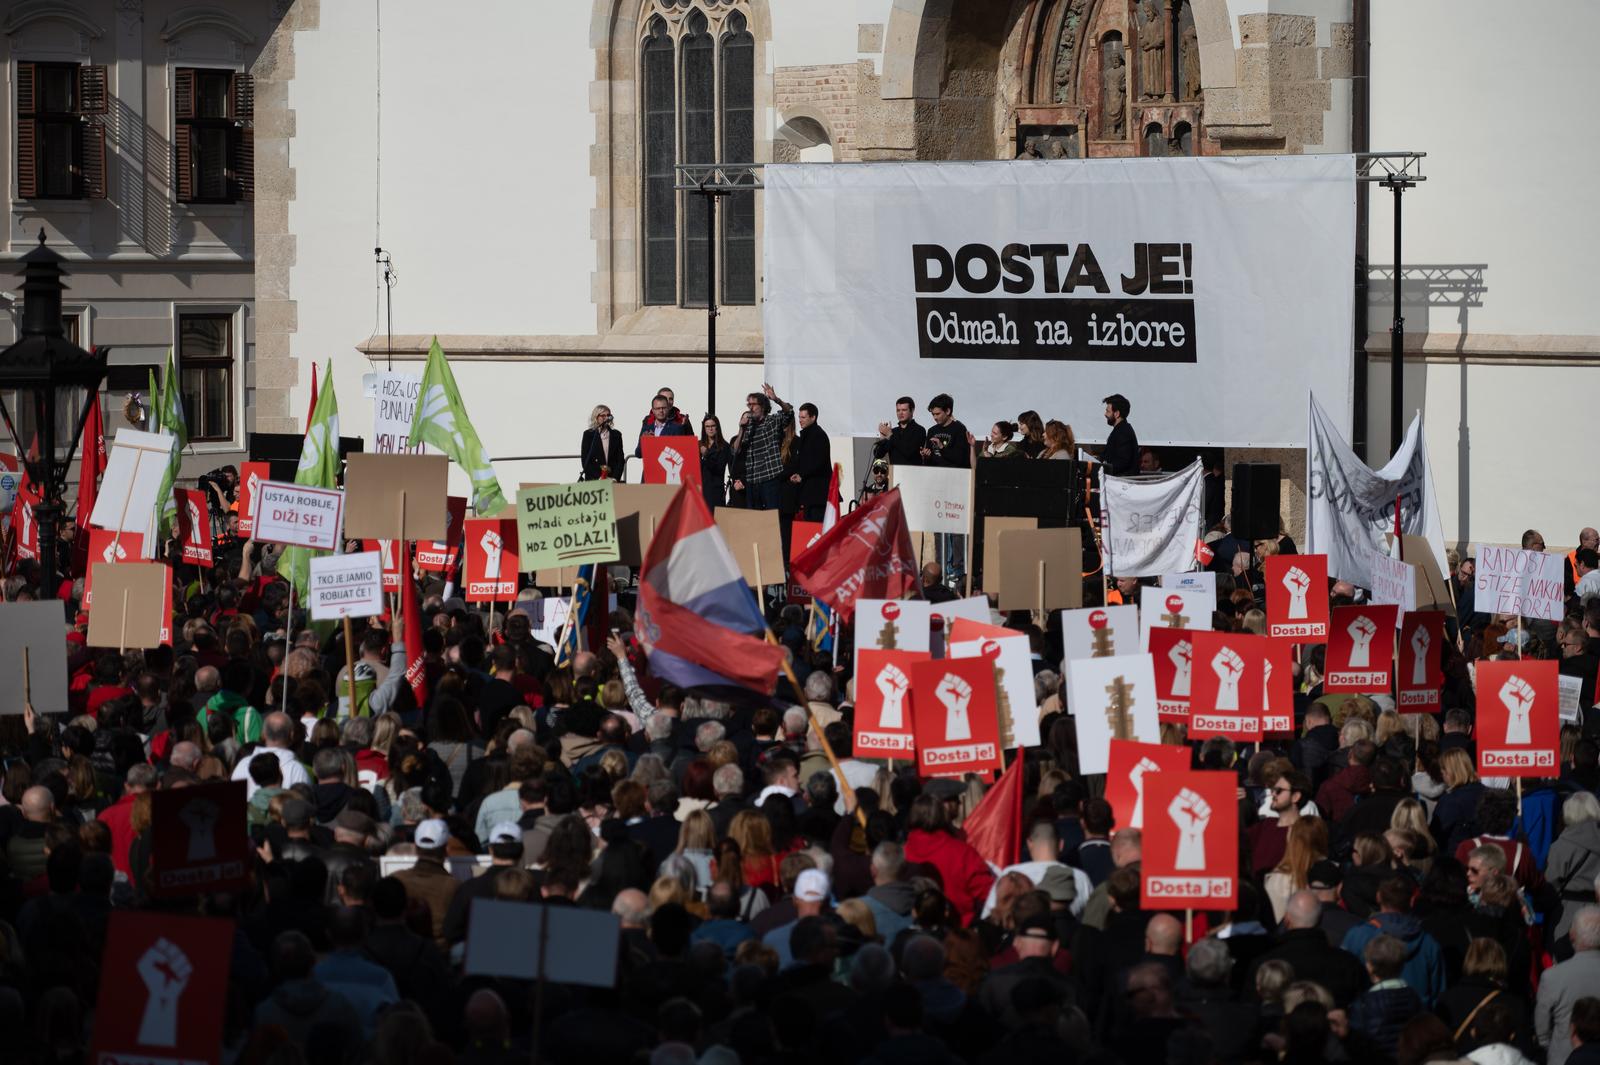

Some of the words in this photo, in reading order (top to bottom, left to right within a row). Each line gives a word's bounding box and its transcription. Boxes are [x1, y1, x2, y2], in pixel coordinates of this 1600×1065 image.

[912, 243, 1111, 294] DOSTA
[1120, 243, 1193, 295] JE!
[926, 310, 1019, 345] Odmah
[1034, 320, 1072, 345] na
[1087, 313, 1186, 347] izbore
[265, 491, 294, 504] USTAJ
[297, 496, 334, 511] ROBLJE,
[526, 486, 609, 512] BUDUĆNOST:
[272, 508, 298, 523] DIŽI
[302, 514, 323, 527] SE!
[527, 515, 562, 531] mladi
[567, 510, 606, 528] ostaju
[526, 541, 548, 552] HDZ
[553, 522, 616, 549] ODLAZI!
[419, 553, 442, 563] Dosta
[1482, 547, 1551, 576] RADOST
[317, 575, 333, 585] TKO
[336, 574, 343, 583] JE
[383, 575, 394, 584] sta
[320, 588, 353, 600] ROBIJAT
[471, 584, 499, 593] Dosta
[502, 583, 513, 595] je!
[1528, 579, 1564, 602] NAKON
[1497, 595, 1552, 620] IZBORA
[1272, 626, 1306, 636] Dosta
[1309, 625, 1323, 636] je!
[1330, 674, 1367, 684] Dosta
[1369, 674, 1385, 686] je!
[1401, 693, 1425, 703] Dosta
[1426, 692, 1438, 704] je!
[1195, 718, 1236, 729] Dosta
[1239, 719, 1256, 732] je!
[1271, 719, 1287, 731] je!
[859, 735, 899, 747] Dosta
[926, 749, 970, 763] Dosta
[975, 746, 993, 761] je!
[1485, 754, 1529, 765] Dosta
[1533, 752, 1552, 767] je!
[1151, 880, 1201, 894] Dosta
[1207, 880, 1229, 897] je!
